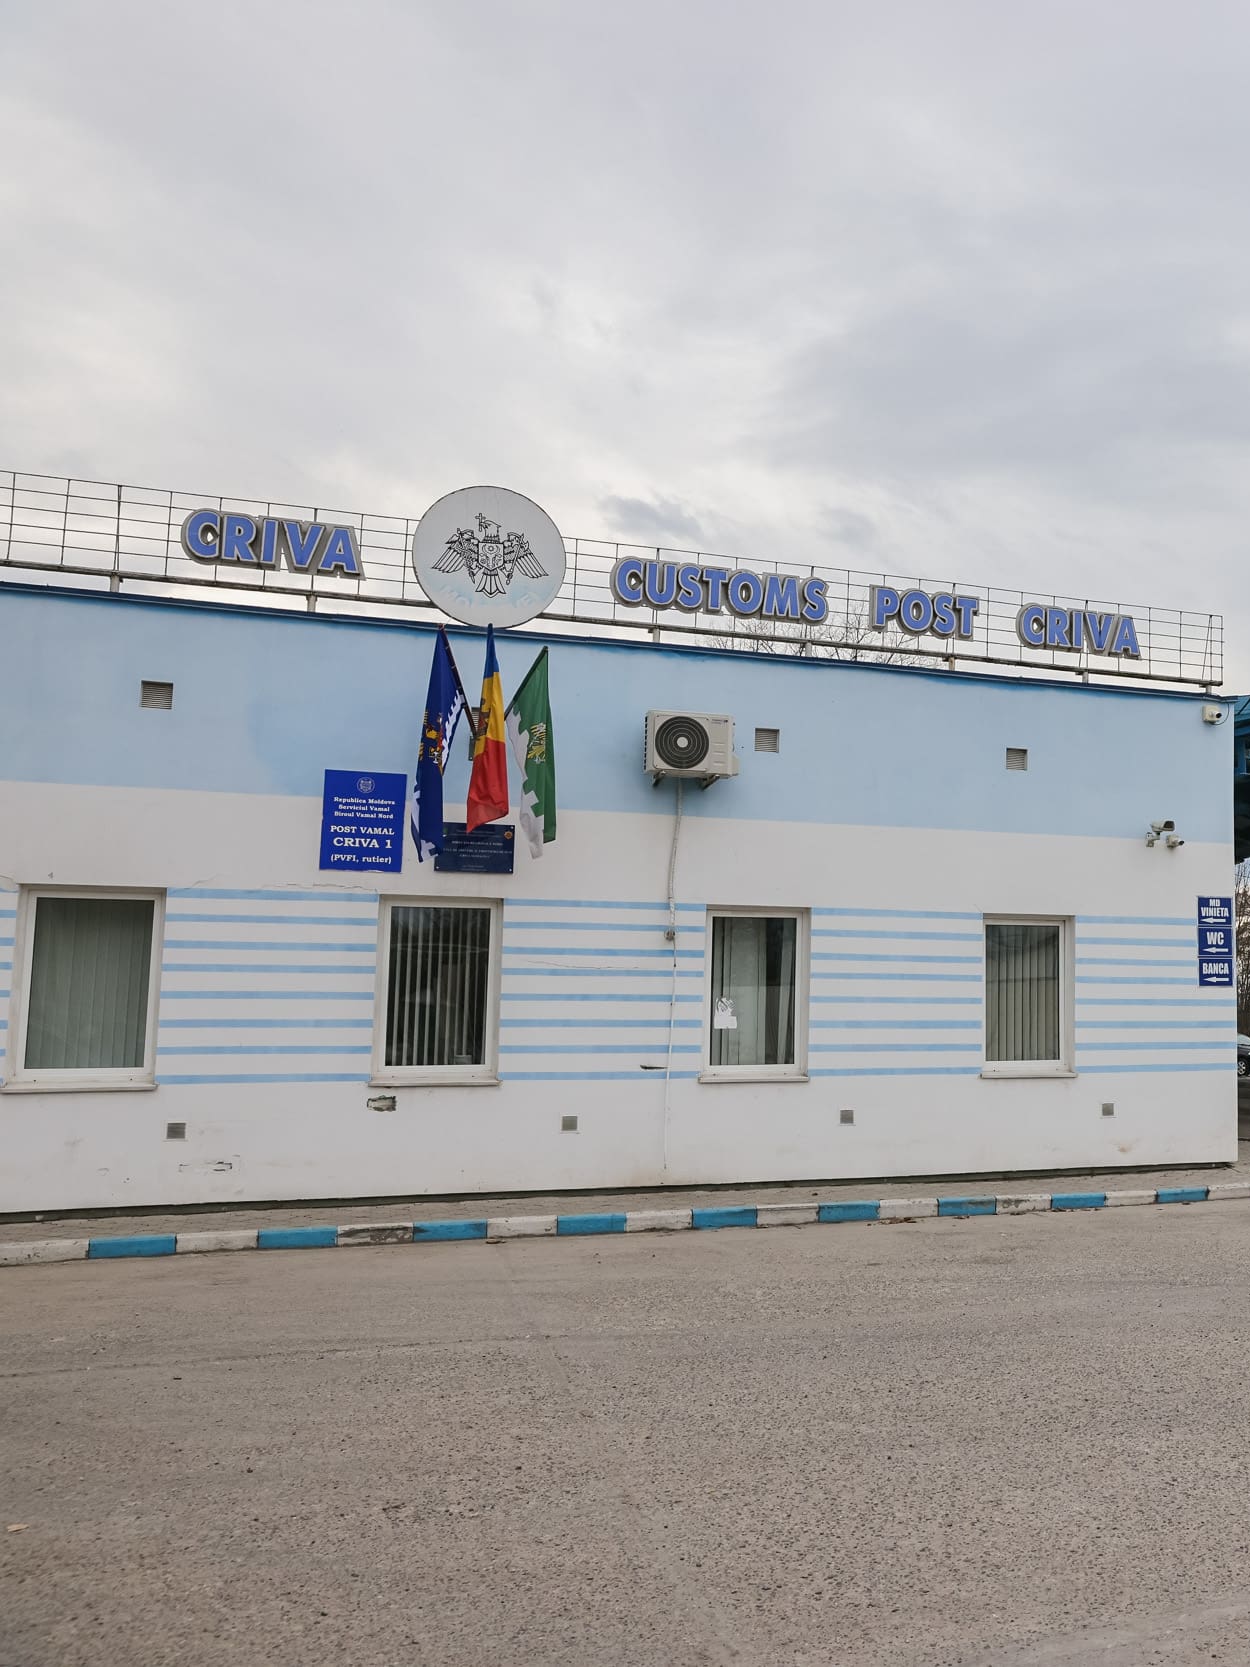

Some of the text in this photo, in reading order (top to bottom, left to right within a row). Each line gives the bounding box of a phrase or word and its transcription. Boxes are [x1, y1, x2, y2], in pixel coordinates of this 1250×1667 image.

[184, 509, 363, 577] CRIVA
[613, 557, 1141, 659] CUSTOMS POST CRIVA
[330, 825, 395, 835] POST VAMAL
[333, 837, 392, 849] CRIVA 1
[362, 855, 392, 864] rutier)
[1209, 899, 1221, 907] MD
[1201, 907, 1229, 917] VINIETA
[1206, 931, 1225, 945] WC
[1202, 962, 1230, 975] BANCA
